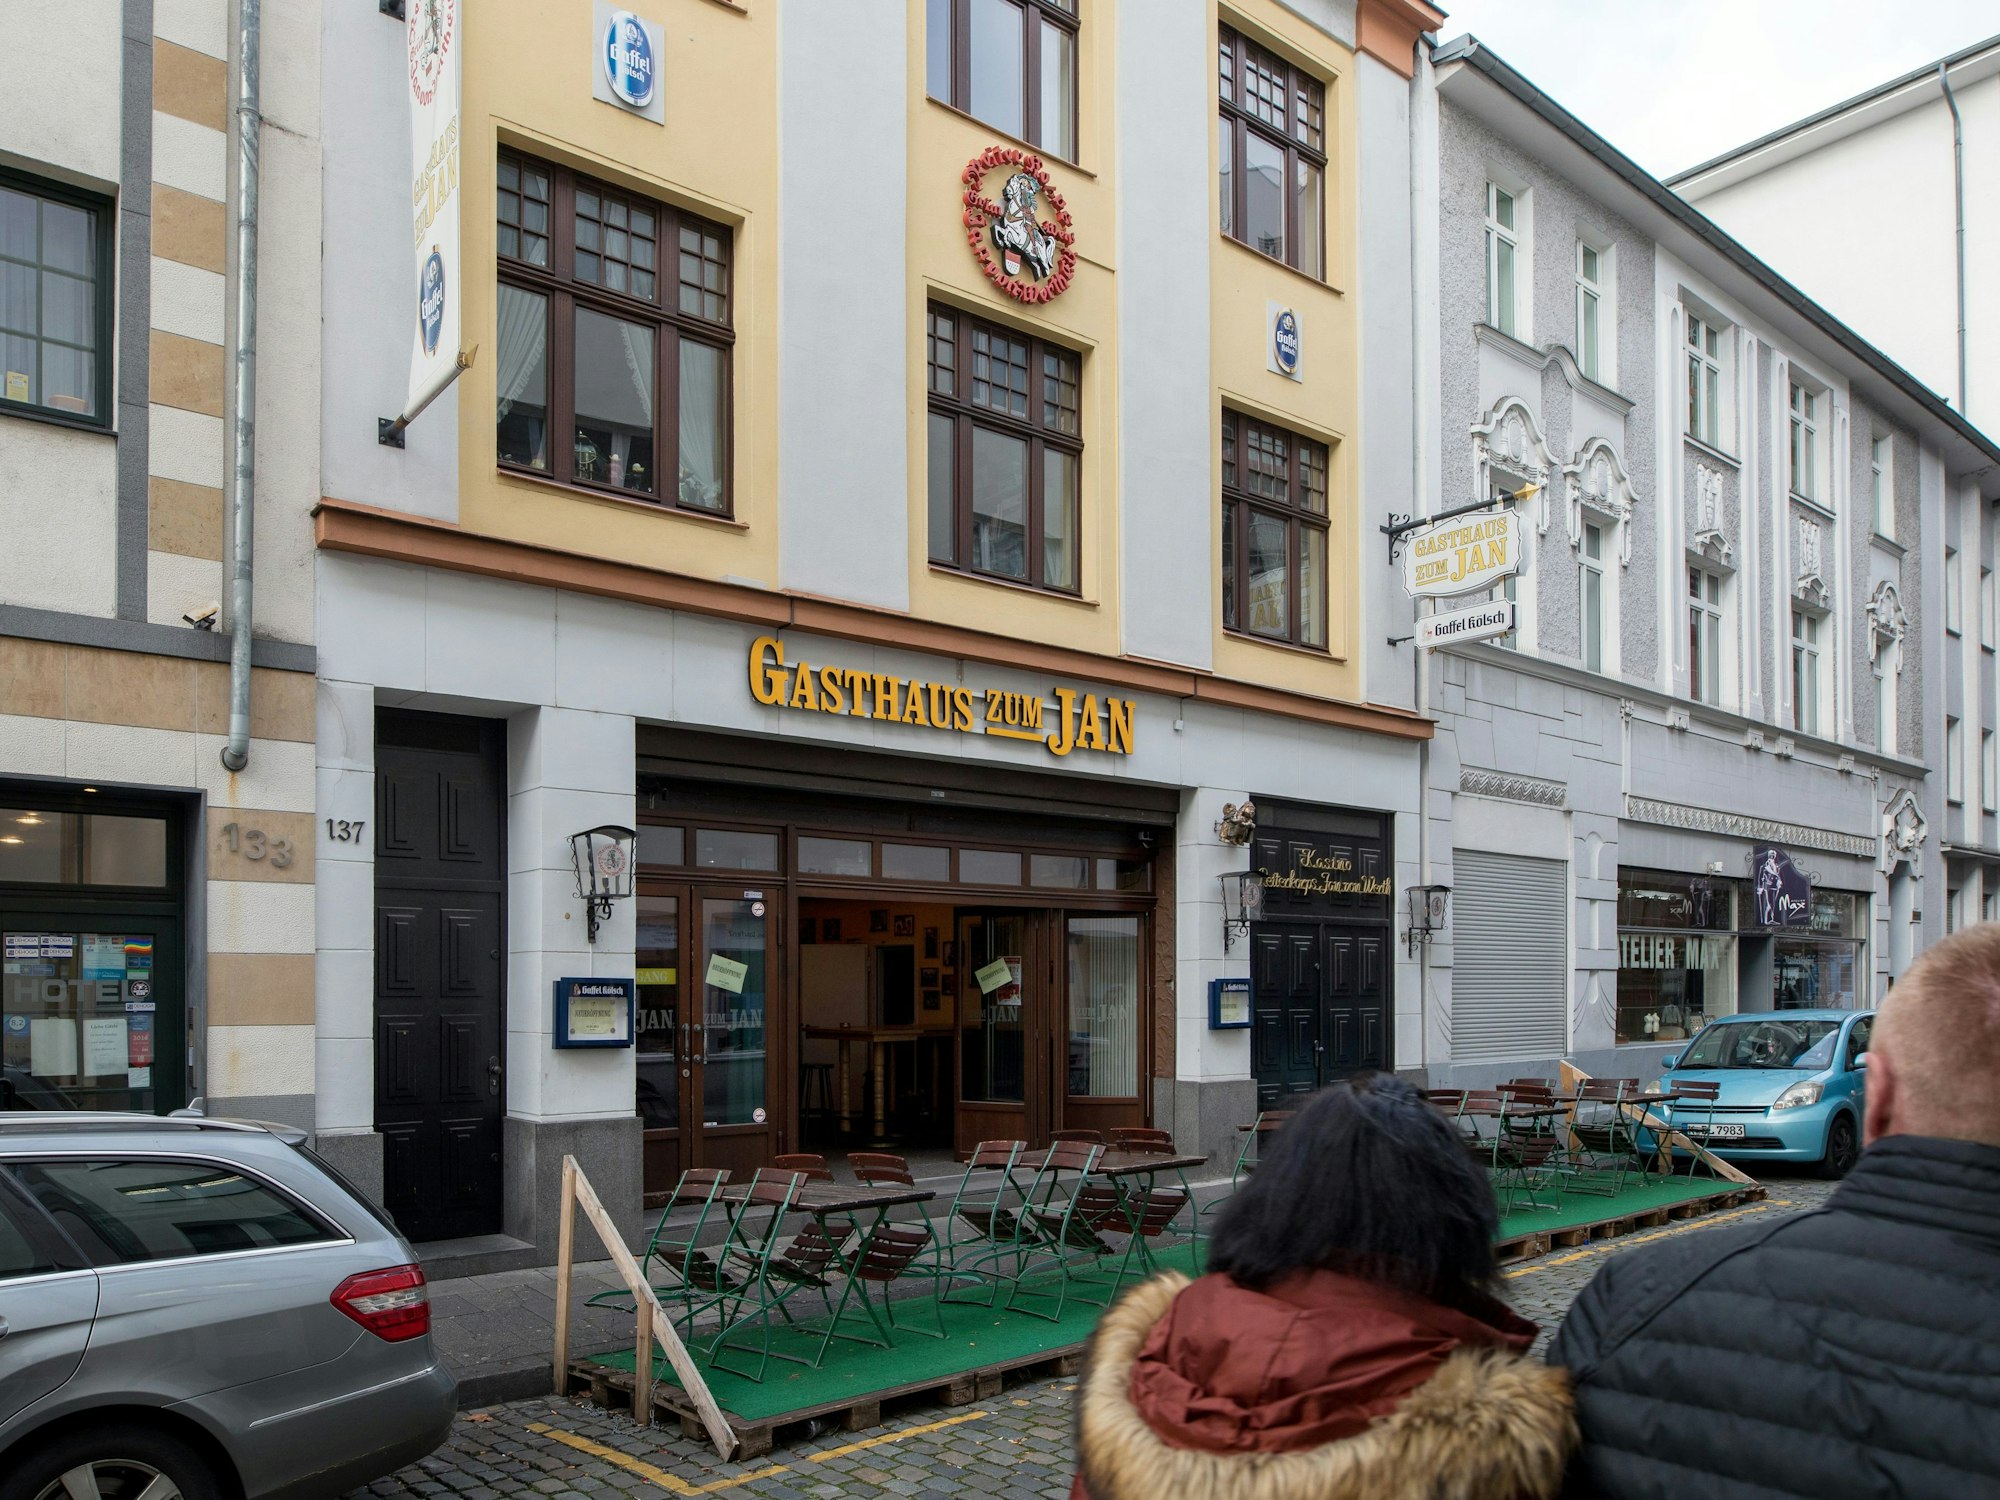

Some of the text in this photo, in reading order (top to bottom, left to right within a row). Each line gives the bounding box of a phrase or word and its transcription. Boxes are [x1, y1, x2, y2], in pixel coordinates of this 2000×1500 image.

[618, 63, 645, 83] ölsch
[425, 145, 457, 229] JAN
[1414, 516, 1508, 558] GASTHAUS
[1415, 537, 1508, 583] ZUM JAN
[1435, 610, 1505, 637] Gaffel Kölsch
[748, 635, 1136, 756] GASTHAUS ZUM JAN
[325, 818, 365, 845] 137
[223, 822, 293, 869] 133
[1300, 848, 1352, 872] Kasino
[1319, 871, 1342, 895] Jan
[1779, 893, 1806, 918] Max
[1686, 937, 1719, 970] MAX
[14, 979, 146, 1003] HOTEL
[582, 986, 624, 995] Gaffel Kölsch
[636, 1009, 674, 1033] JAN
[703, 1008, 763, 1032] ZUM JAN
[990, 1005, 1019, 1025] JAN
[1097, 1003, 1130, 1023] JAN
[1716, 1125, 1743, 1136] 7983
